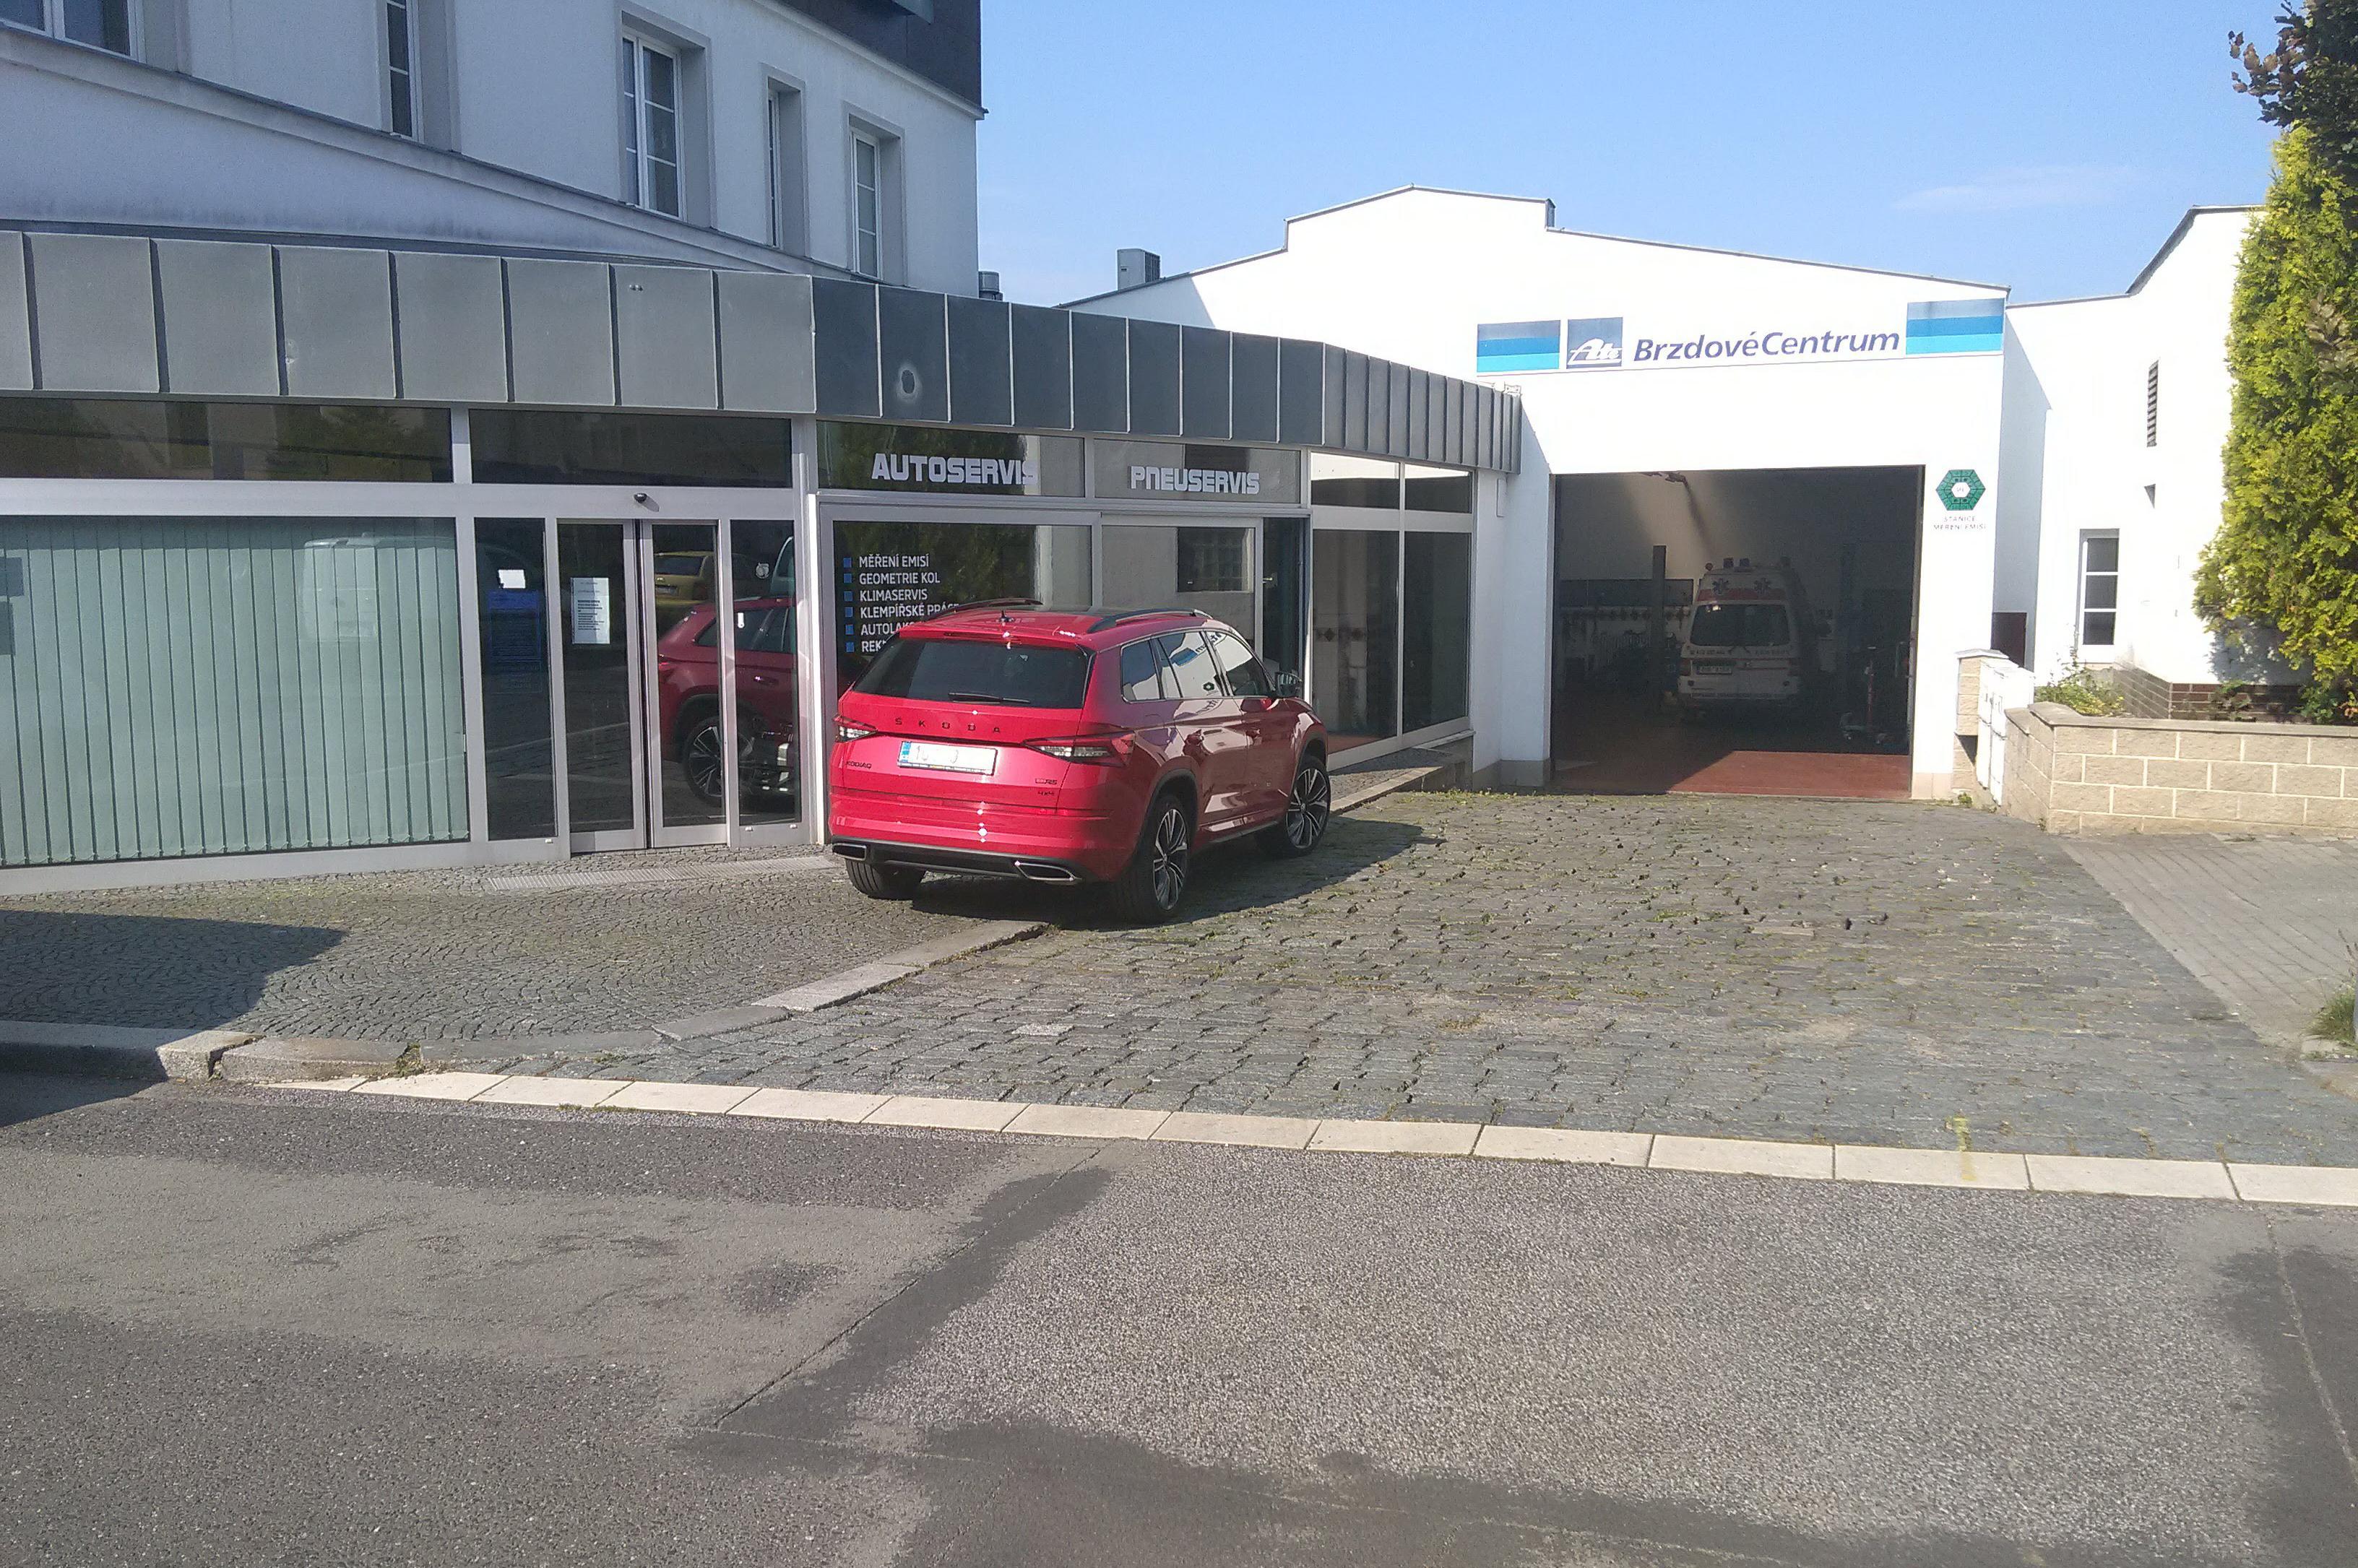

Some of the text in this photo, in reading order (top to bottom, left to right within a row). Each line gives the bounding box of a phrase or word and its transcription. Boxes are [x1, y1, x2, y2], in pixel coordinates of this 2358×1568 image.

[871, 453, 1039, 485] AUTOSERVIS
[1130, 465, 1260, 495] PNEUSERVIS
[859, 553, 930, 568] MĚŘENÍ EMISÍ
[859, 572, 941, 585] GEOMETRIE KOL
[860, 589, 928, 602] KLIMASERVIS
[860, 602, 925, 618] KLEMPÍŘSKÉ
